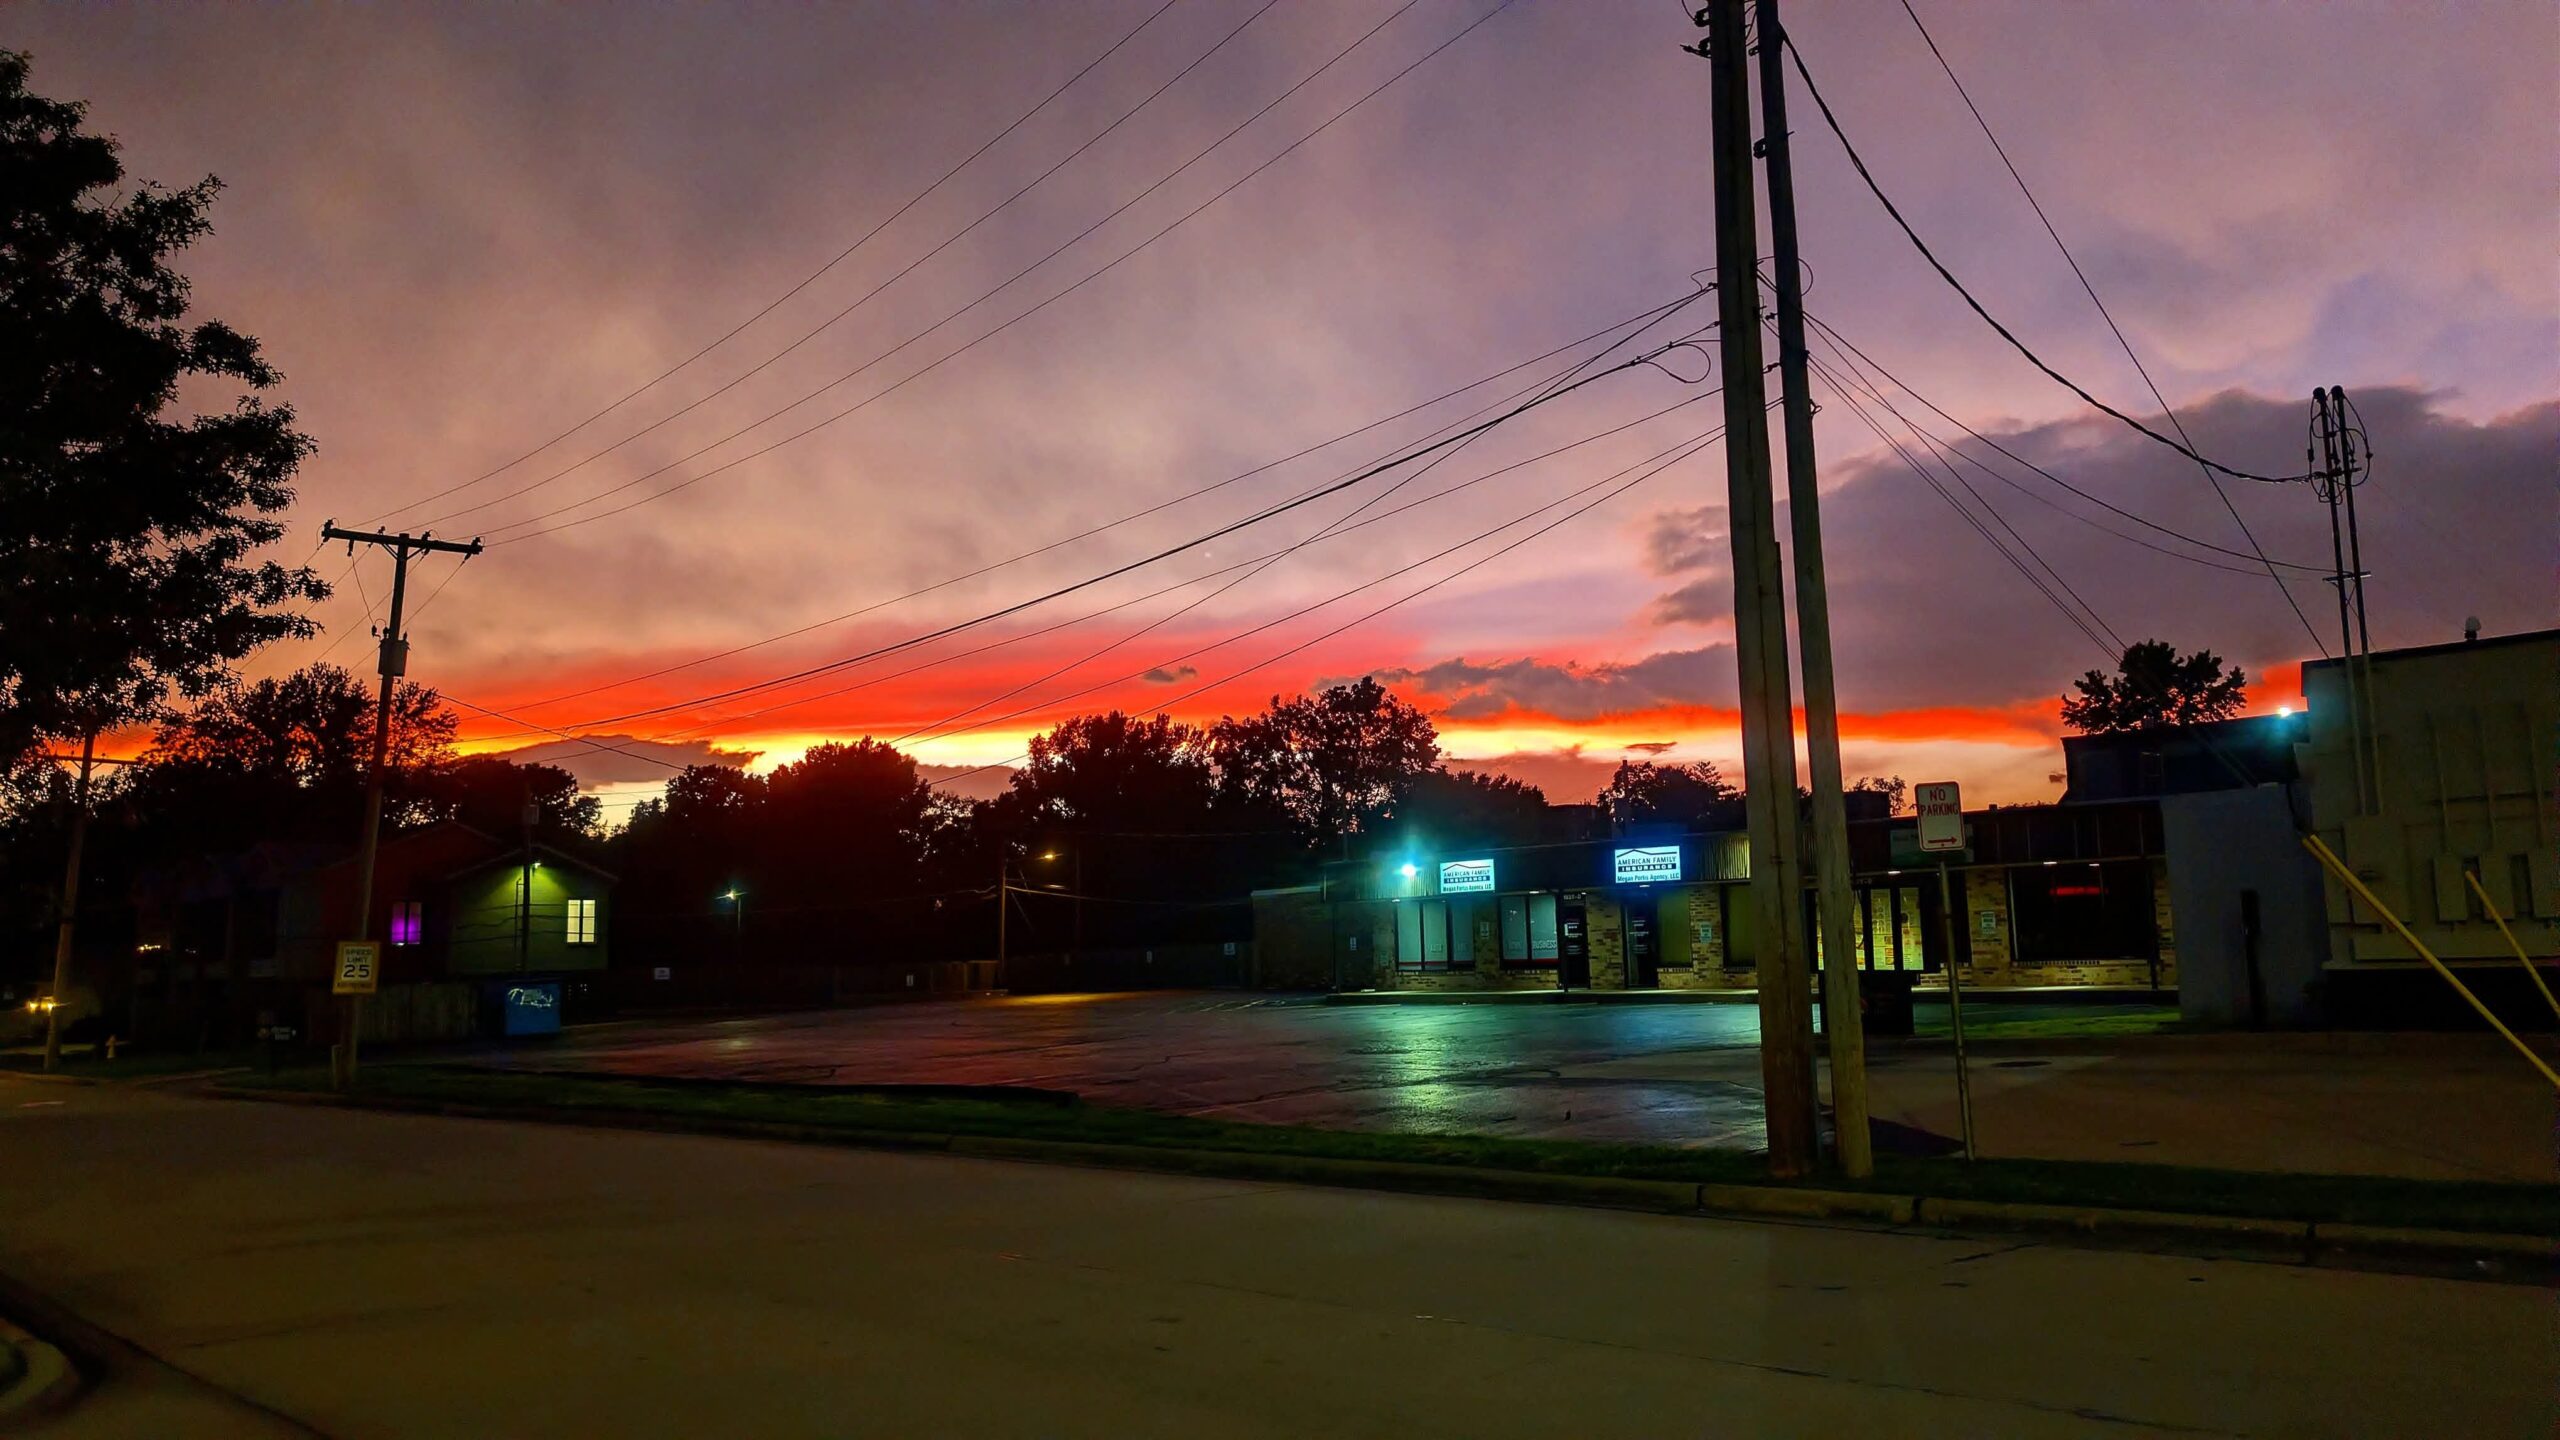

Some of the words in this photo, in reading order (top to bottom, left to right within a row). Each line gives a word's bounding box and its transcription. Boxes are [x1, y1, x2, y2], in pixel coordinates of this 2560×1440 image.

[1930, 788, 1946, 801] NO
[1920, 803, 1959, 816] PARKING
[1618, 858, 1651, 866] AMERICAN
[1621, 864, 1673, 872] INSURANCE
[1670, 872, 1679, 880] LLC
[343, 964, 369, 977] 25
